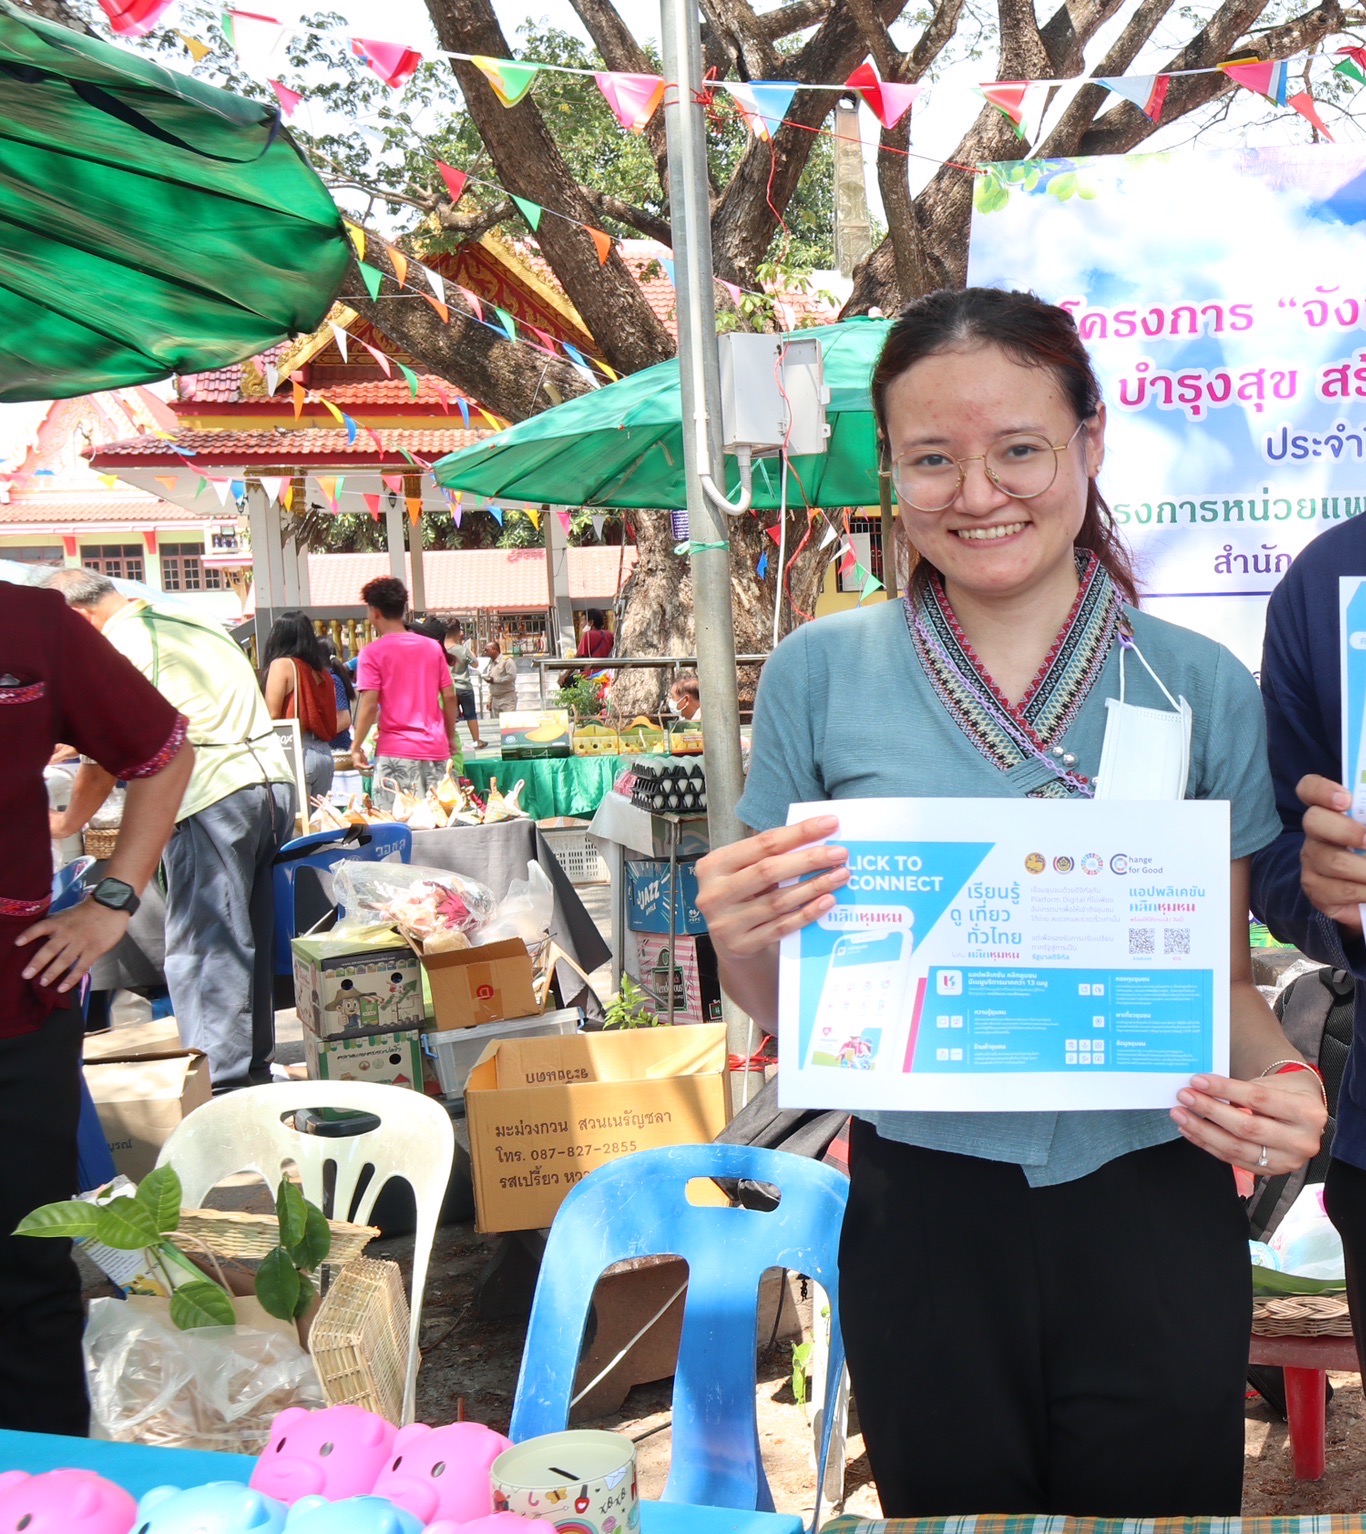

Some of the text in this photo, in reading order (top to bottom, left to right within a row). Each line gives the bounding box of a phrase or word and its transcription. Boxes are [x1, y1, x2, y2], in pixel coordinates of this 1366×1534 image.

[1119, 362, 1298, 416] บำรุงสุข
[895, 855, 922, 872] TO
[846, 875, 943, 892] CONNECT
[967, 881, 1020, 904] เรียนรู้
[1129, 885, 1206, 898] แอปพลิเคชัน
[637, 880, 660, 910] JAZZ
[828, 908, 903, 926] คลิกชุมชน
[950, 900, 1011, 926] ดู เที่ยว
[1129, 900, 1196, 915] คลิกชุมชน
[967, 923, 1022, 944] ทั่วไทย
[495, 1120, 568, 1138] มะม่วงกวน
[496, 1140, 637, 1163] โทร. 087-827-2855
[500, 1165, 560, 1189] รสเปรี้ยว
